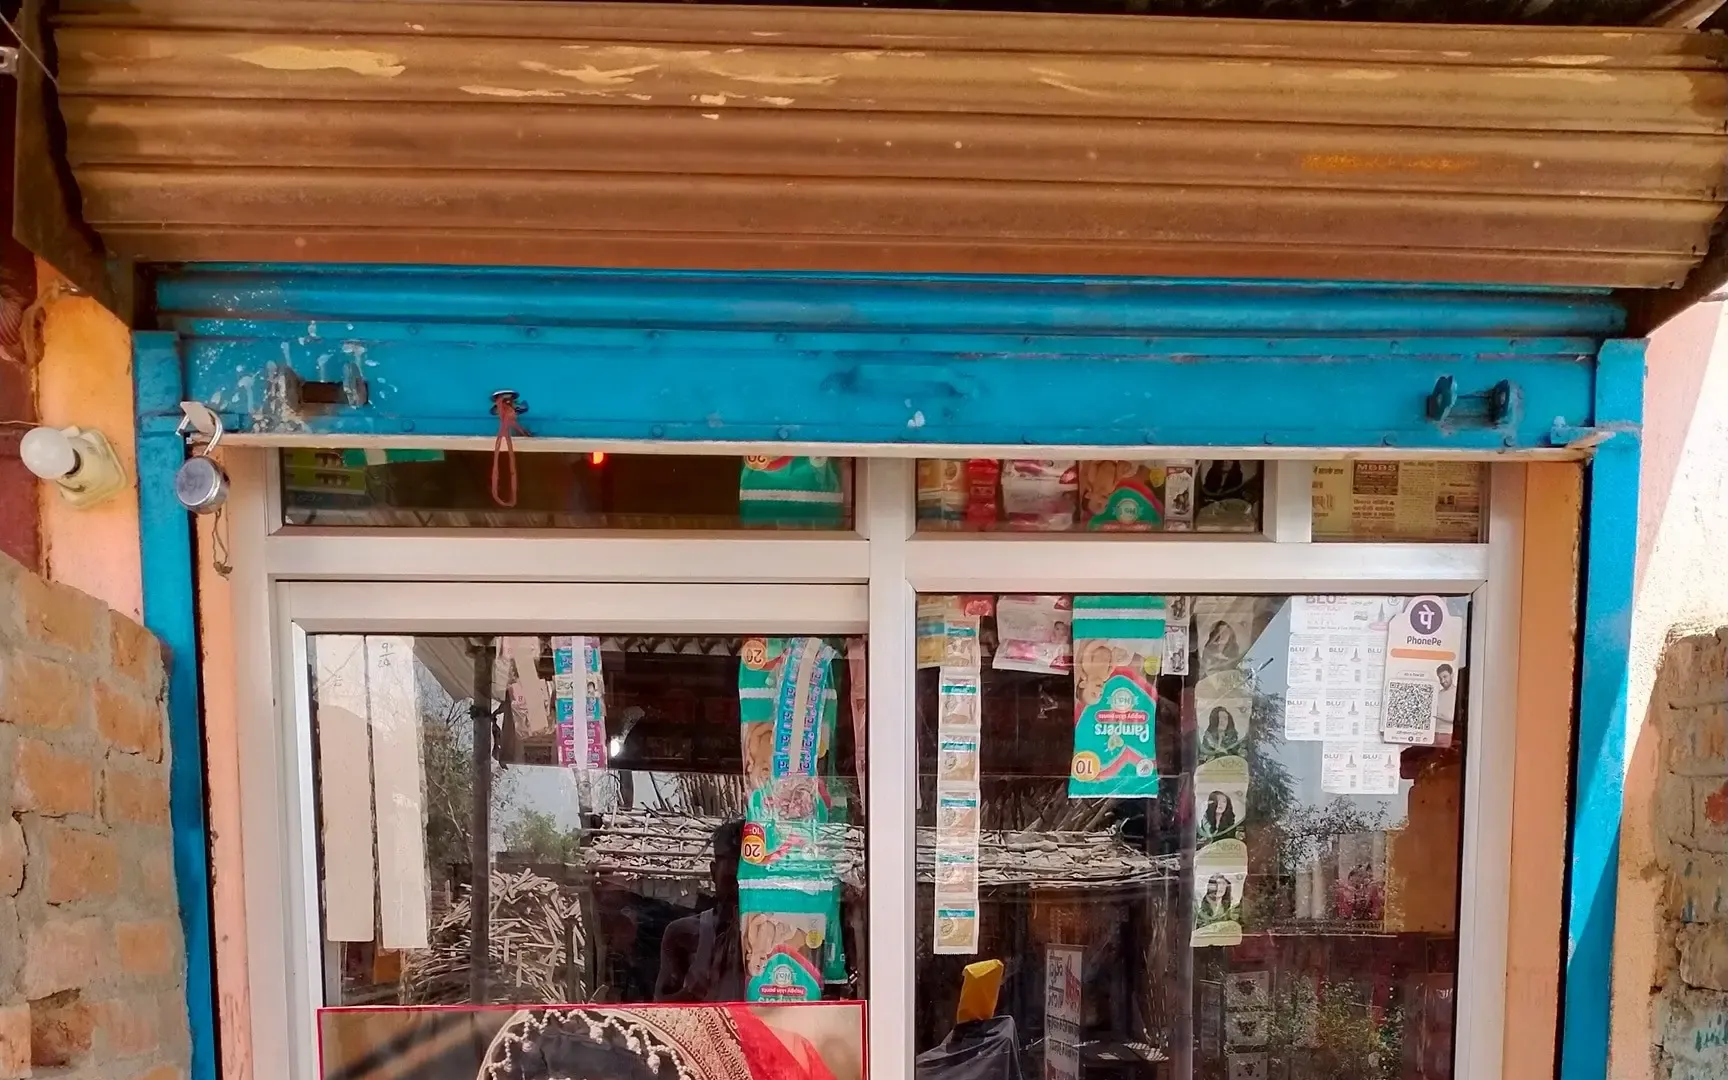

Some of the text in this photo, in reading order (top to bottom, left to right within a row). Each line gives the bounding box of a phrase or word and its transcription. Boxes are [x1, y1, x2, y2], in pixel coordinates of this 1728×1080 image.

[1418, 605, 1439, 630] पे
[1406, 636, 1442, 646] PhonePe
[1094, 722, 1150, 743] Pampers
[1075, 760, 1093, 774] 10
[744, 843, 761, 858] 20
